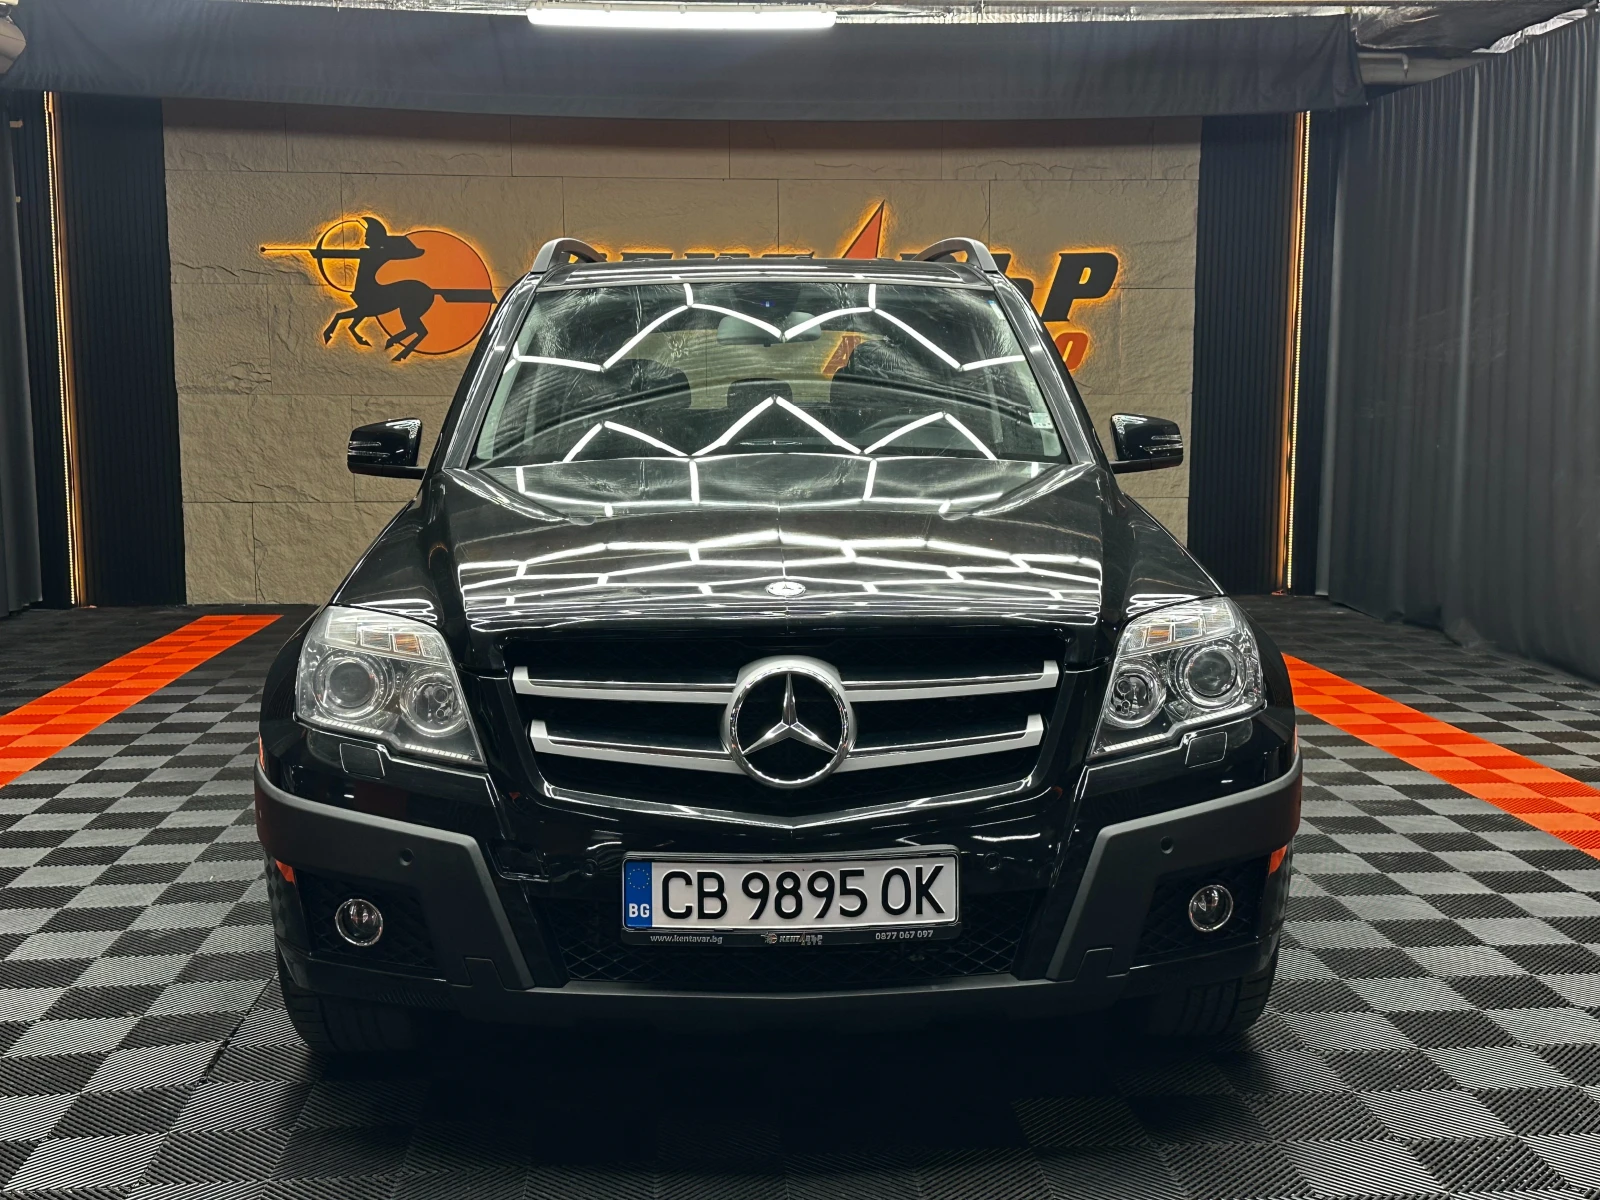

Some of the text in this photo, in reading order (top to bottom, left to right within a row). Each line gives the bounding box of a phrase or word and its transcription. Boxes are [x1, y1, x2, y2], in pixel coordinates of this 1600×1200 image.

[662, 864, 946, 920] CB 9895 OK
[628, 903, 650, 918] BG
[650, 934, 723, 945] www.kentavar.bg
[875, 929, 934, 940] 0877 067 097
